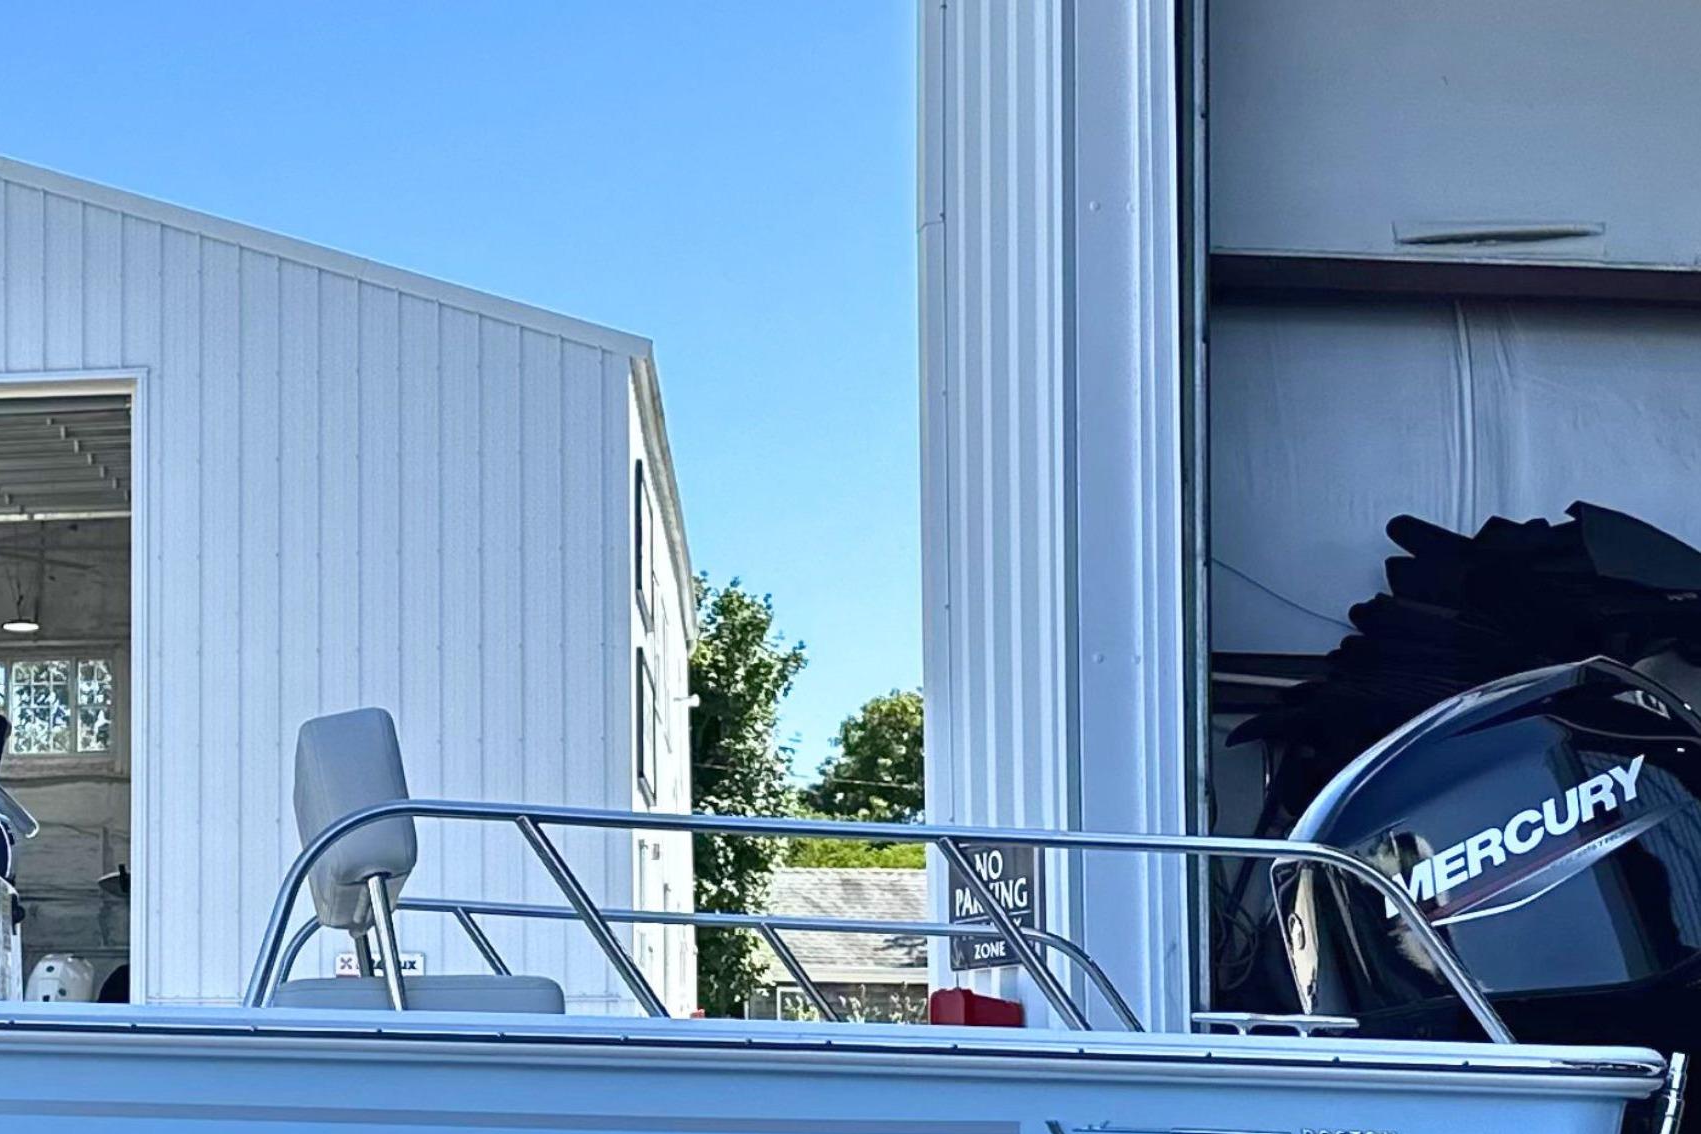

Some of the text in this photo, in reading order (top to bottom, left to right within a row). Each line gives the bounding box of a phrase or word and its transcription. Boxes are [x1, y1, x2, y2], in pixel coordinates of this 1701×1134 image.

[1385, 754, 1645, 919] MERCURY
[974, 850, 1004, 881] NO
[974, 941, 1007, 960] ZONE
